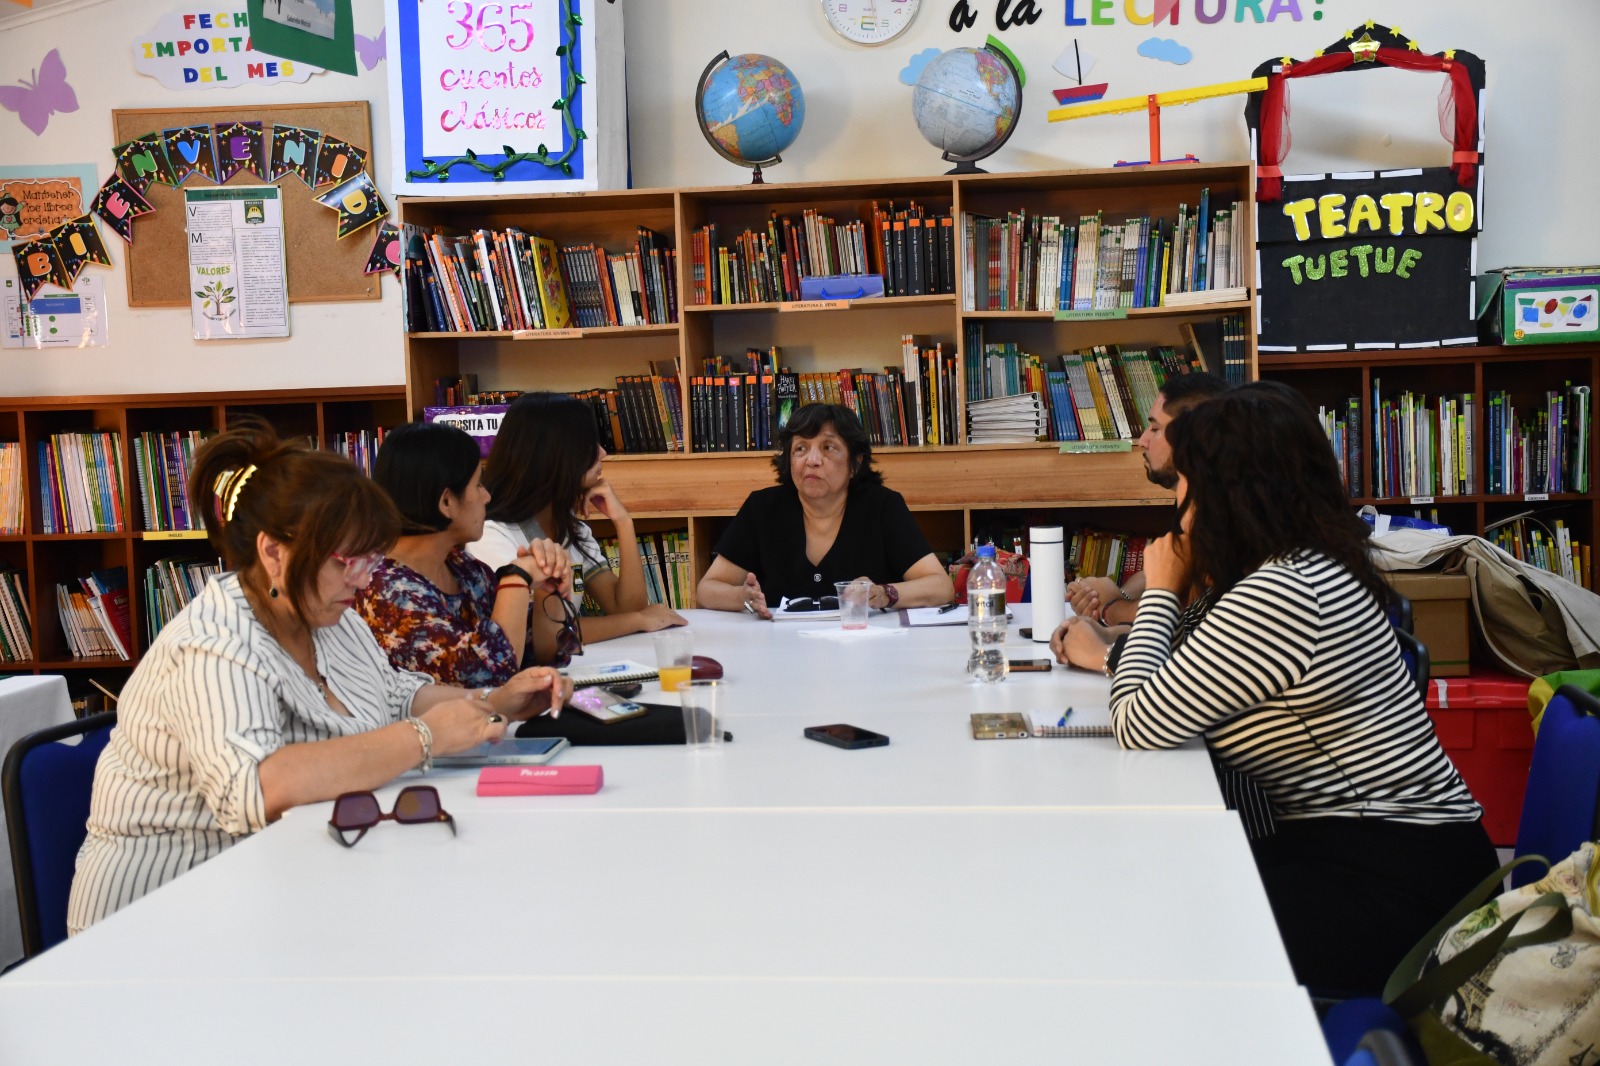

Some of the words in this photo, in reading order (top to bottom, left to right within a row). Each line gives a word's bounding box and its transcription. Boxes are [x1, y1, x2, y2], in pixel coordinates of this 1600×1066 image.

[446, 0, 534, 52] 365
[949, 0, 978, 31] a
[996, 0, 1042, 31] la
[1065, 0, 1323, 27] LECURA!
[141, 36, 255, 58] IMPORT
[183, 66, 228, 83] DEL
[247, 61, 295, 79] MES
[440, 61, 543, 91] cuentos
[440, 100, 547, 132] clásicos
[23, 190, 74, 200] Mantener
[43, 202, 73, 212] libros
[1283, 191, 1474, 241] TEATRO
[196, 264, 231, 276] VALORES
[1281, 244, 1423, 285] TUETUE
[776, 383, 798, 394] POTTER
[780, 374, 796, 385] HARRY
[486, 418, 499, 430] TU
[975, 600, 994, 608] vital
